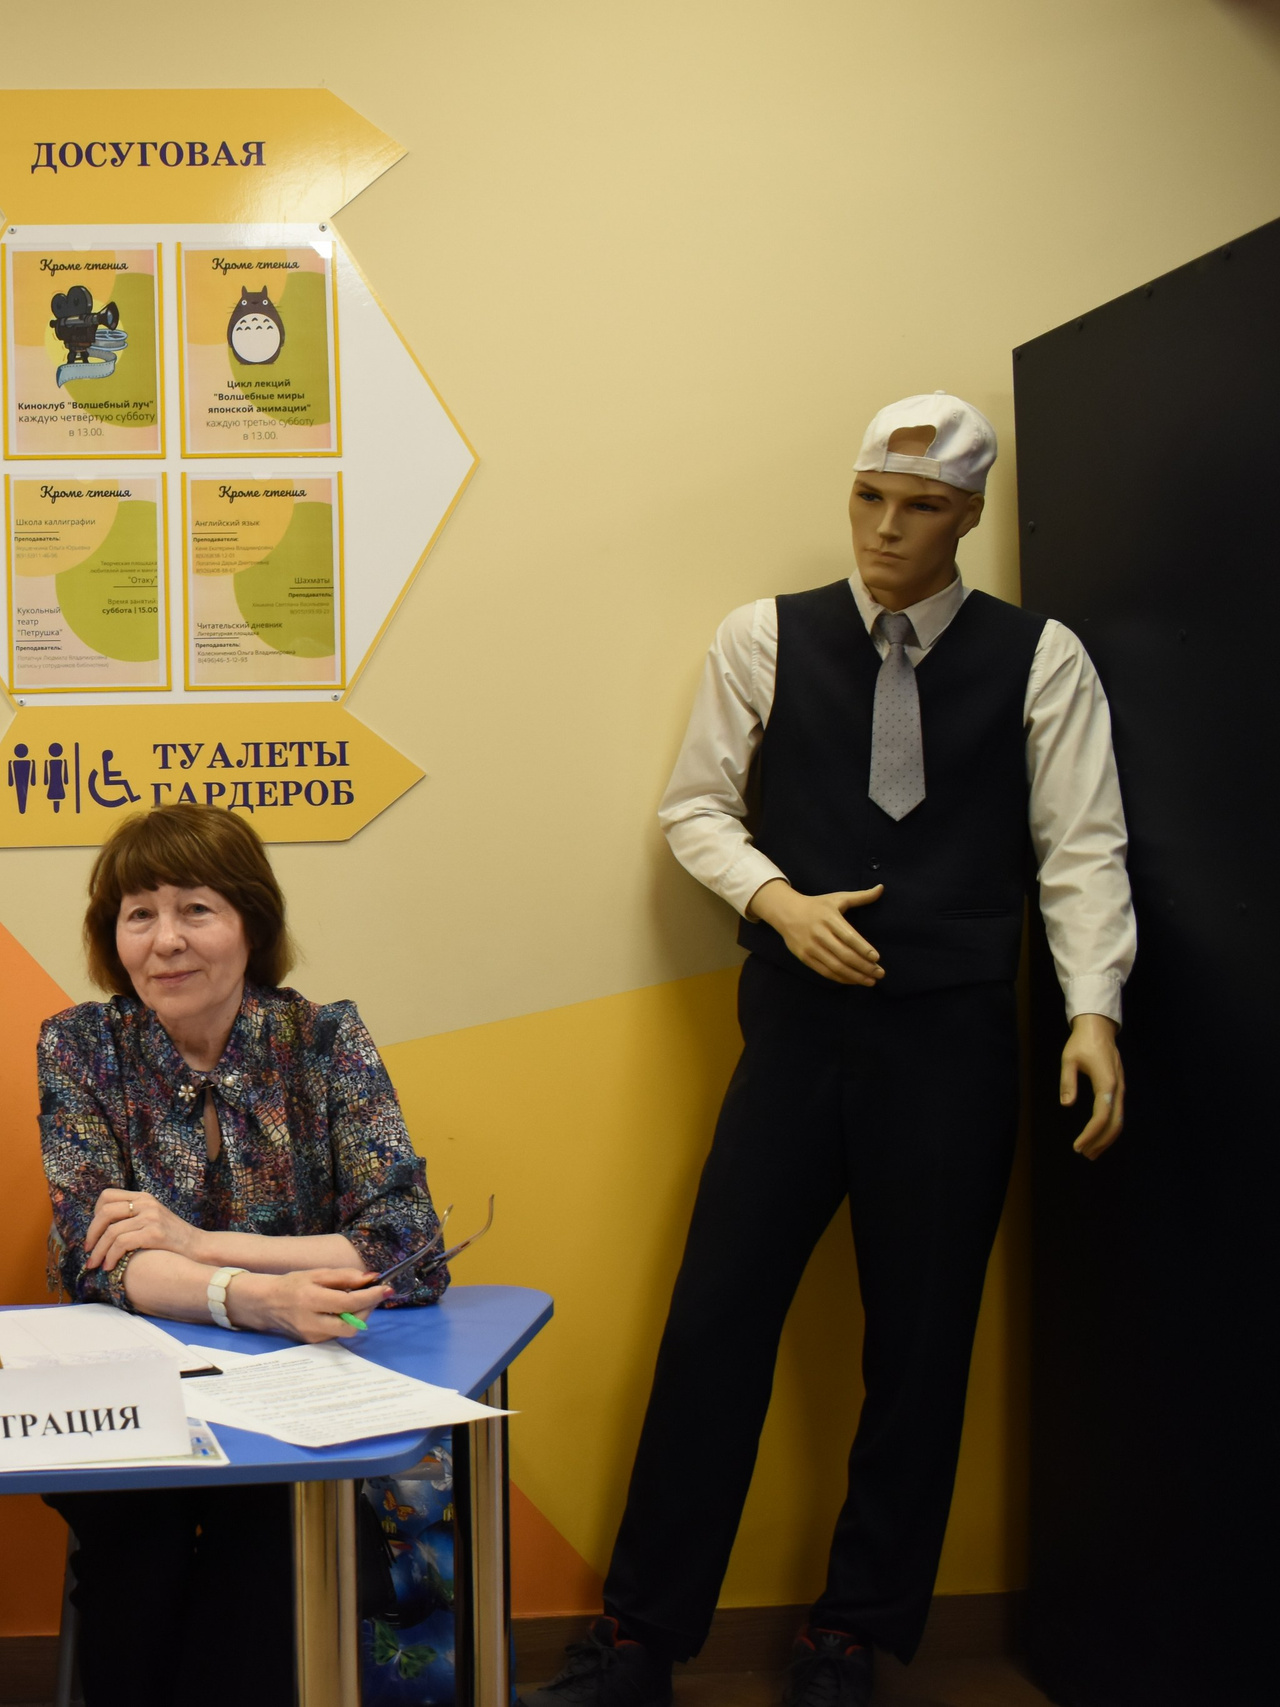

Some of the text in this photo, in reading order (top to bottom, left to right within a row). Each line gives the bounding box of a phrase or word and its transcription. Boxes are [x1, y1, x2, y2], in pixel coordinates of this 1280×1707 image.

[31, 141, 266, 174] ДОСУГОВАЯ
[40, 259, 128, 277] Кроме чтения
[212, 258, 300, 276] Кроме чтения
[227, 379, 291, 389] Цикл лекций
[214, 393, 305, 401] "Волшебные миры
[18, 400, 154, 411] Киноклуб "Волшебный луч"
[208, 404, 311, 414] японской анимации"
[18, 412, 155, 424] каждую четвёртую субботу
[206, 417, 314, 428] каждую третью субботу
[78, 428, 105, 437] 13.00.
[252, 432, 278, 440] 13.00.
[40, 485, 132, 504] Кроме чтения
[219, 485, 307, 504] Кроме чтения
[16, 518, 96, 527] Школа каллиграфии
[195, 519, 240, 527] Английский
[17, 607, 61, 615] Кукольный
[102, 606, 132, 615] суббота
[197, 621, 282, 630] Читательский дневник
[17, 628, 63, 637] "Петрушка"
[153, 741, 350, 770] ТУАЛЕТЫ
[151, 780, 354, 813] ГАРДЕРОБ
